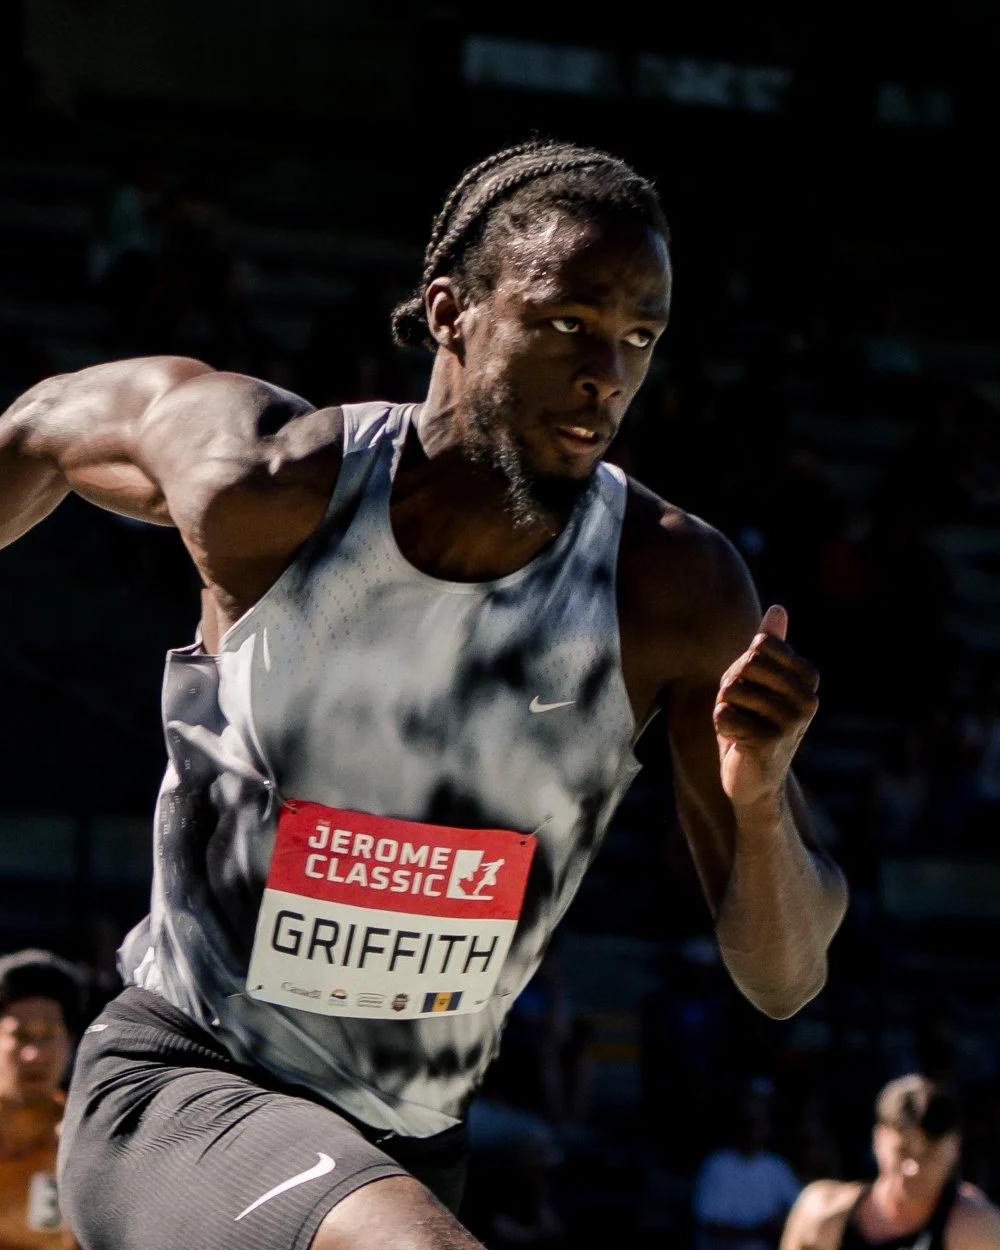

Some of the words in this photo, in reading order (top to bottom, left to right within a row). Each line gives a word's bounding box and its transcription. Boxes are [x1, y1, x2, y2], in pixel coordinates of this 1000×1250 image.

[308, 825, 452, 870] JEROME
[305, 854, 446, 897] CLASSIC
[271, 910, 499, 975] GRIFFITH
